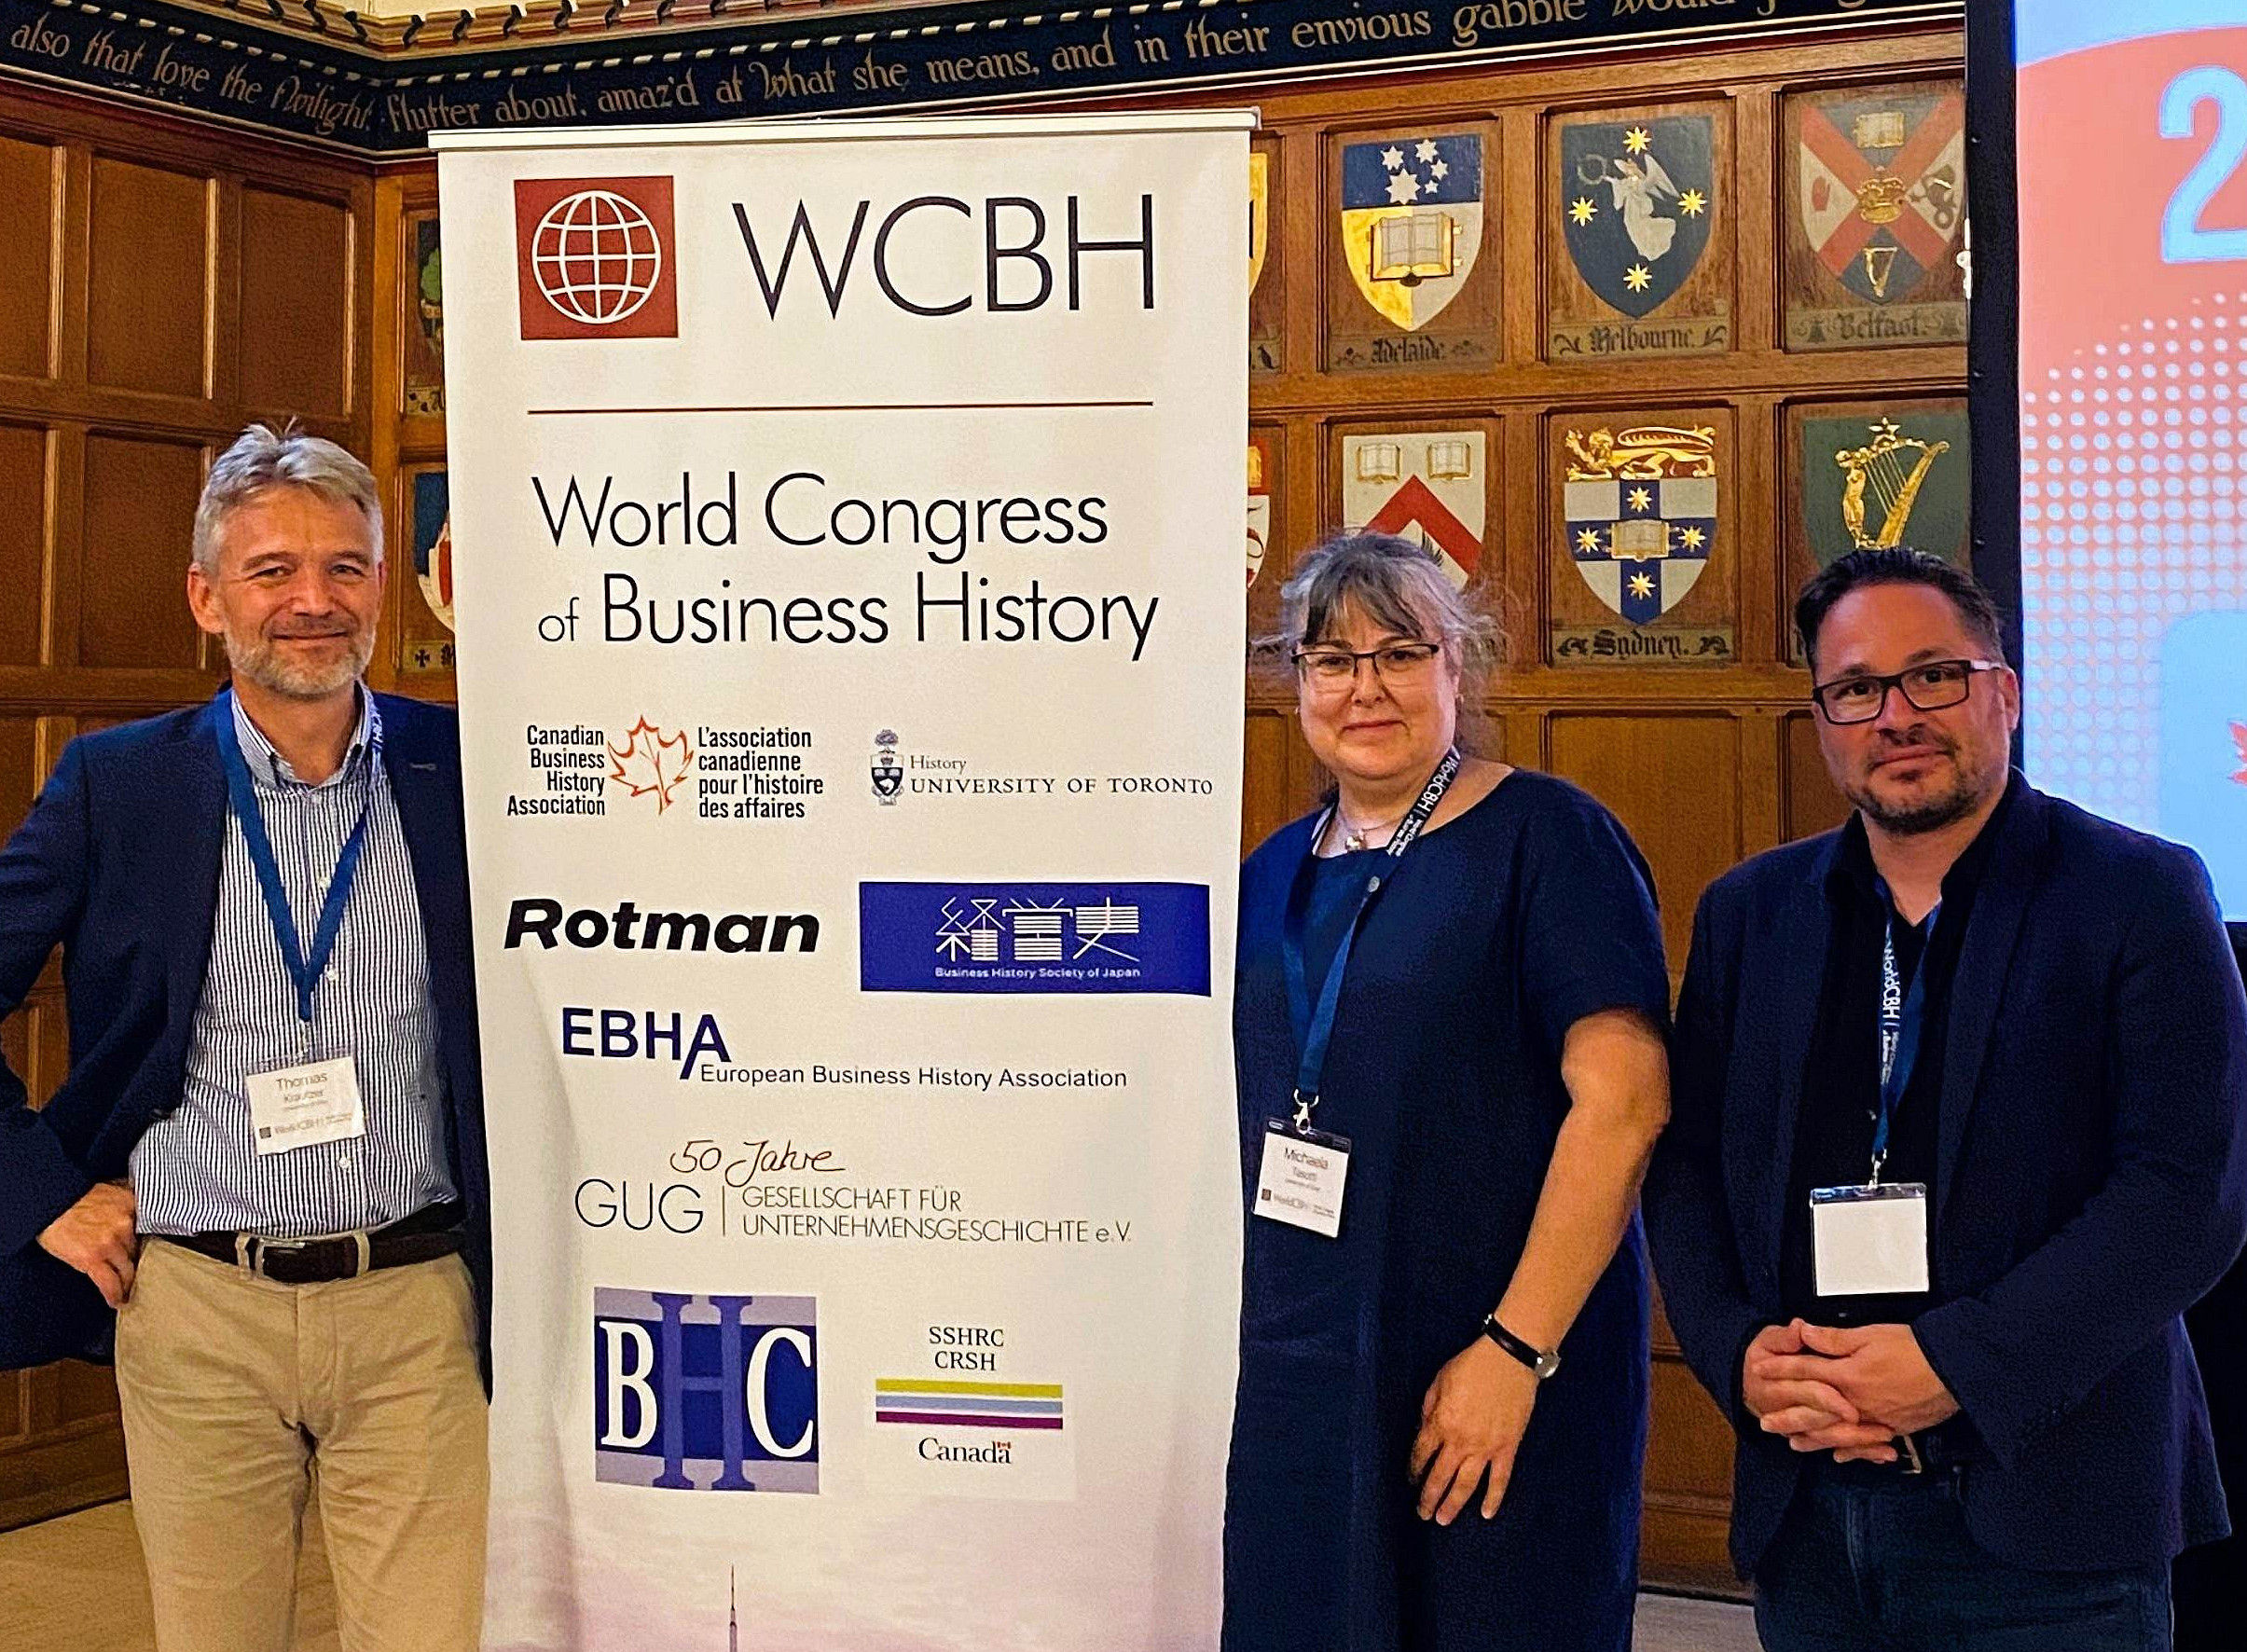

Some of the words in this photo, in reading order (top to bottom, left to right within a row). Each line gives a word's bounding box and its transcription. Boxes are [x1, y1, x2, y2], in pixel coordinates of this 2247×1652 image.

[10, 11, 71, 58] also
[81, 30, 146, 75] that
[152, 42, 210, 92] love
[219, 62, 262, 104] the
[387, 91, 480, 133] flutter
[715, 64, 743, 103] at
[852, 48, 907, 90] she
[1052, 24, 1117, 72] and
[1134, 24, 1170, 63] in
[1184, 14, 1270, 59] their
[1292, 2, 1431, 48] envious
[1453, 0, 1587, 47] gabble
[732, 194, 1154, 321] WCBH
[531, 471, 738, 548] World
[765, 473, 1109, 564] Congress
[538, 598, 580, 643] of
[603, 572, 889, 645] Business
[917, 571, 1159, 662] History
[527, 724, 605, 746] Canadian
[698, 726, 812, 748] L'association
[531, 748, 605, 769] Business
[698, 750, 801, 772] canadienne
[910, 755, 967, 775] History
[546, 771, 605, 797] History
[699, 778, 738, 794] pour
[743, 774, 824, 795] l'histoire
[911, 778, 1055, 794] UNIVERSITY
[1068, 778, 1097, 793] OF
[1108, 778, 1213, 795] TORONTO
[507, 794, 606, 817] Association
[699, 798, 728, 819] des
[734, 798, 806, 819] affaires
[504, 898, 820, 953] Rotman
[935, 967, 989, 978] Business
[991, 968, 1037, 980] History
[1039, 968, 1083, 980] Society
[1087, 968, 1100, 978] of
[1102, 968, 1141, 980] Japan
[562, 1007, 732, 1080] EBHA
[700, 1064, 805, 1087] European
[813, 1065, 911, 1084] Business
[919, 1067, 992, 1092] History
[999, 1068, 1127, 1088] Association
[670, 1139, 722, 1173] 50
[724, 1139, 847, 1188] Jahre
[574, 1178, 704, 1234] GUG
[742, 1185, 912, 1210] GESELLSCHAFT
[919, 1185, 961, 1212] FÜR
[743, 1214, 1088, 1243] UNTERNEHMENSGESCHICHTE
[929, 1326, 1005, 1347] SSHRC
[935, 1350, 997, 1371] CRSH
[599, 1292, 814, 1492] BHC
[918, 1437, 1013, 1465] Canada
